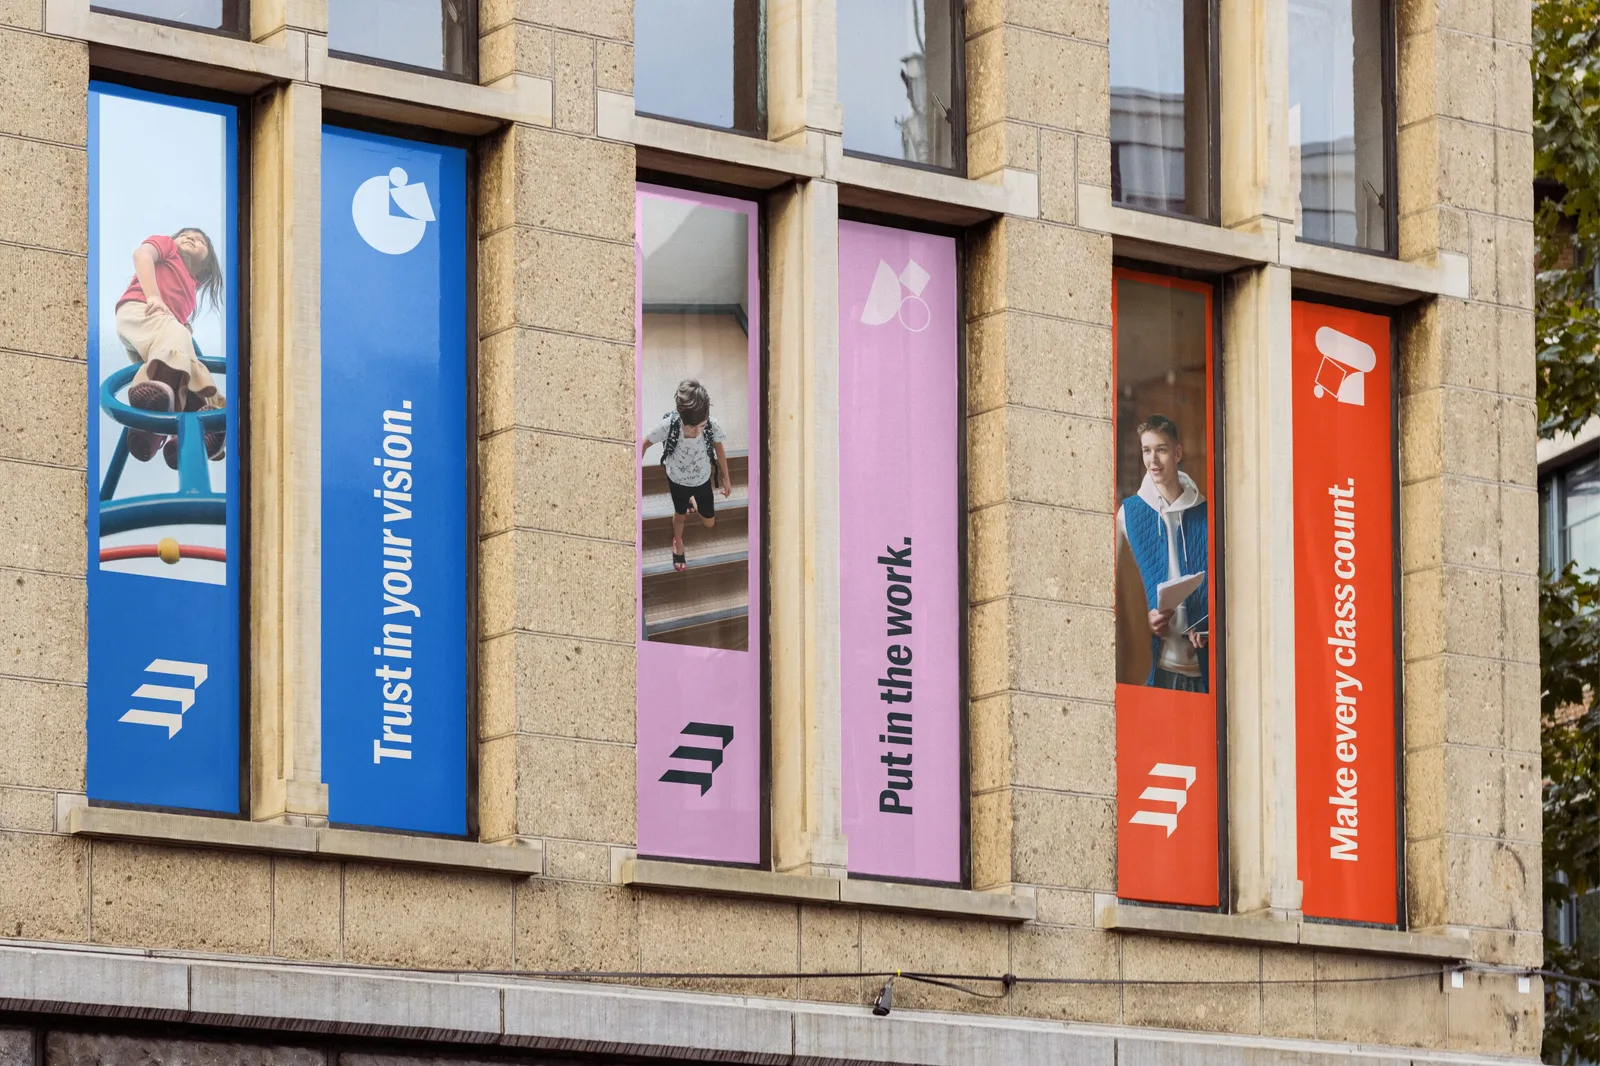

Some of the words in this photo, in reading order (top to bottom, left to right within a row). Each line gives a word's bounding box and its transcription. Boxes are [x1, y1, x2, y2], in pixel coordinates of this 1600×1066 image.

[373, 399, 412, 523] vision.
[383, 528, 421, 618] your
[1328, 477, 1356, 580] count.
[877, 536, 912, 637] work.
[1327, 583, 1357, 667] class
[373, 623, 412, 659] in
[877, 644, 913, 705] the
[373, 664, 412, 765] Trust
[878, 711, 913, 746] in
[1335, 669, 1363, 763] every
[878, 751, 913, 815] Put
[1328, 767, 1358, 862] Make
